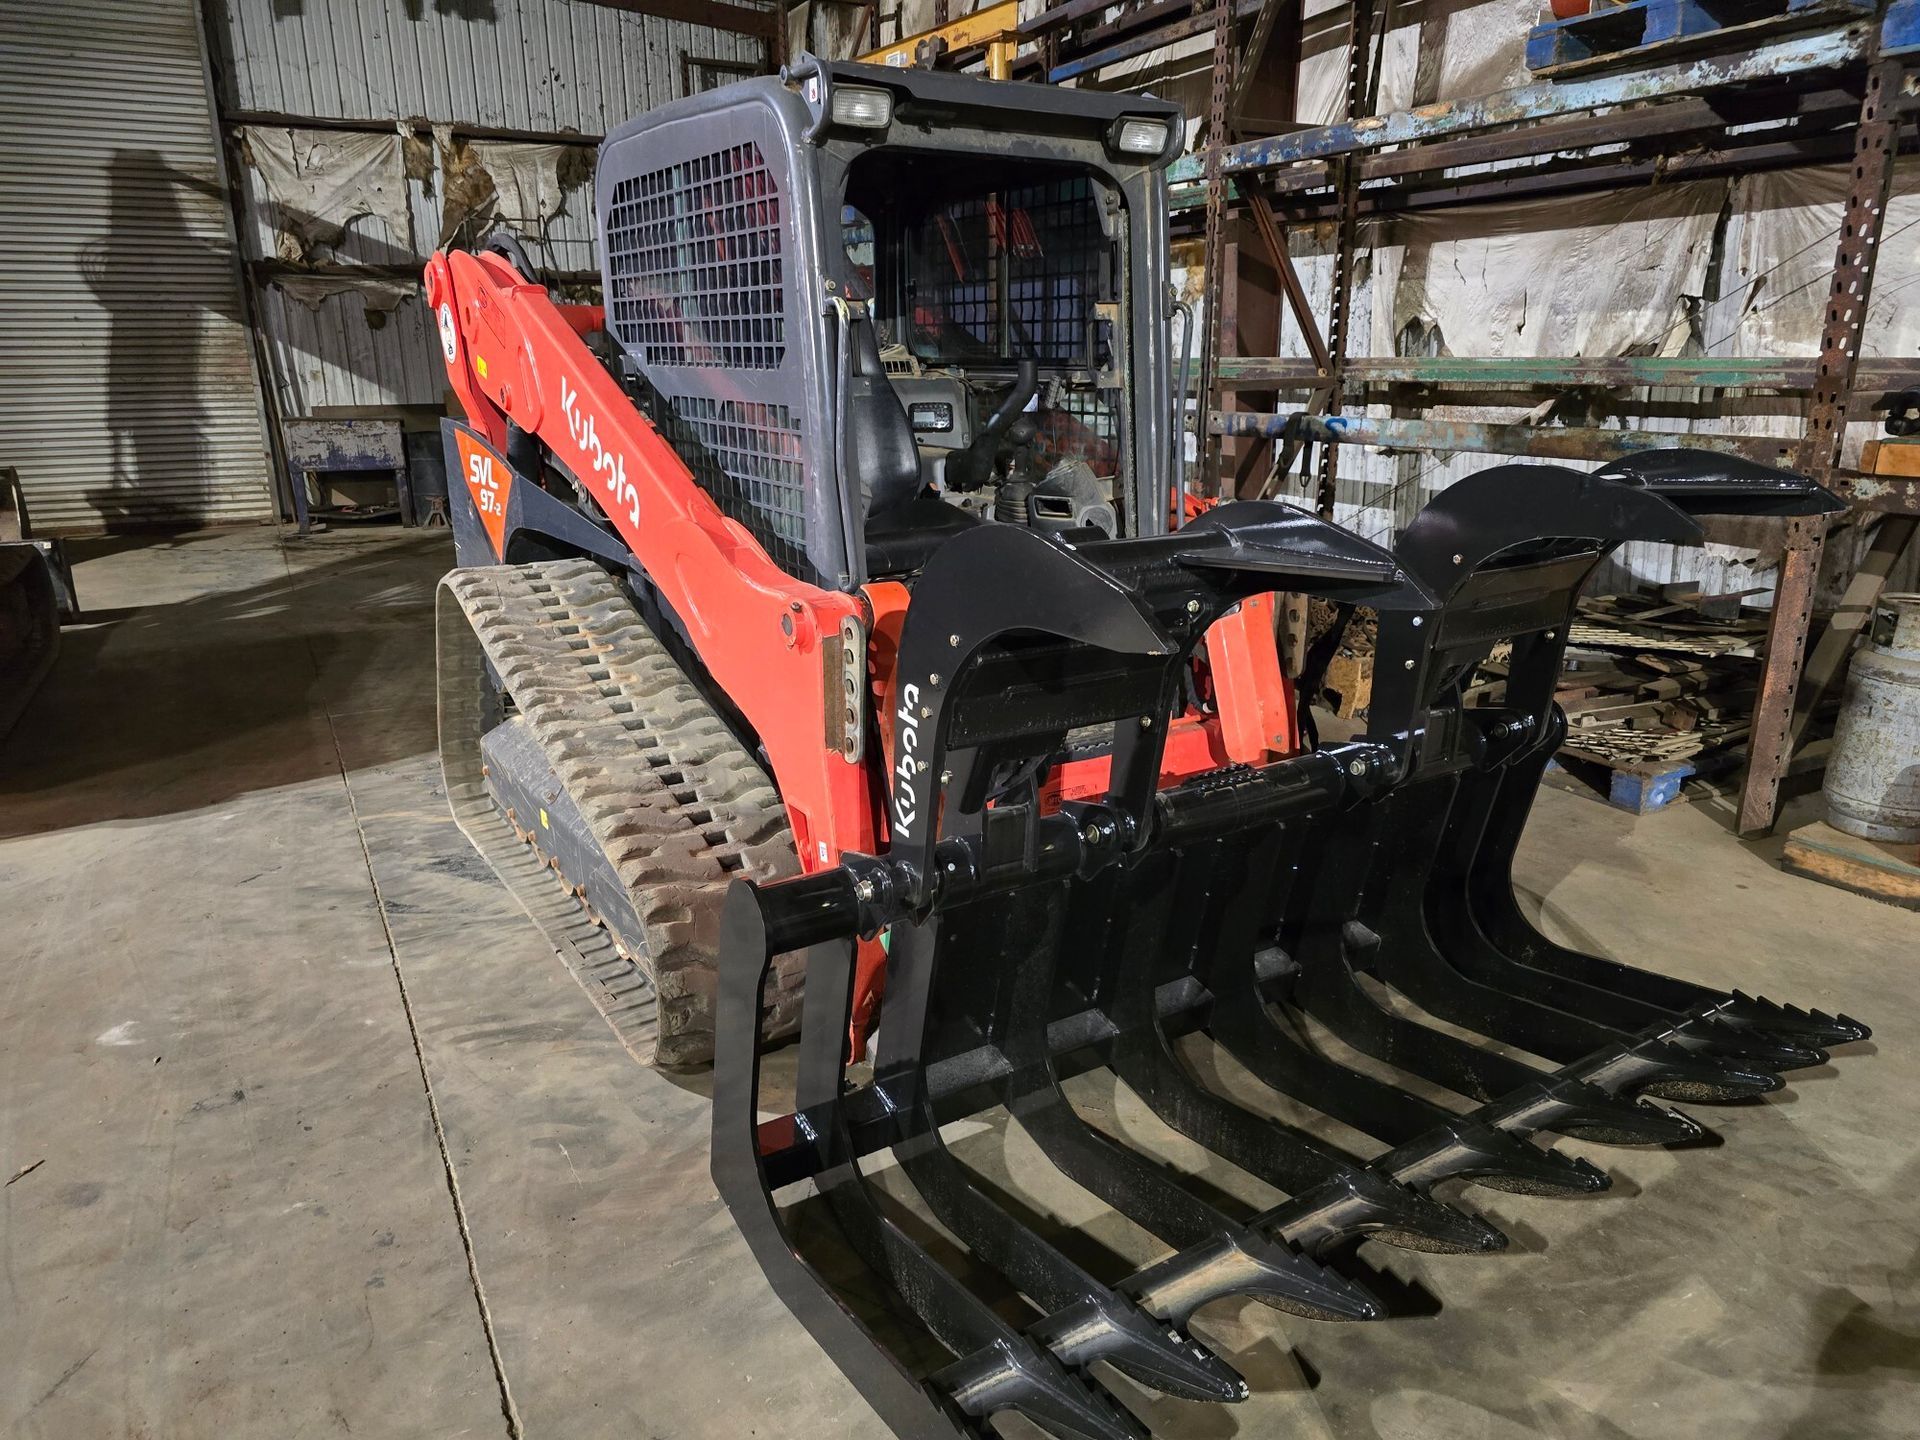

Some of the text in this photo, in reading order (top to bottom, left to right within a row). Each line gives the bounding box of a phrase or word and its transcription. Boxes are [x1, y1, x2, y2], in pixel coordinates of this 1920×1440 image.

[469, 453, 499, 490] SVL
[561, 375, 640, 529] Kubota
[480, 488, 502, 517] 97-2
[894, 683, 920, 839] Kubota
